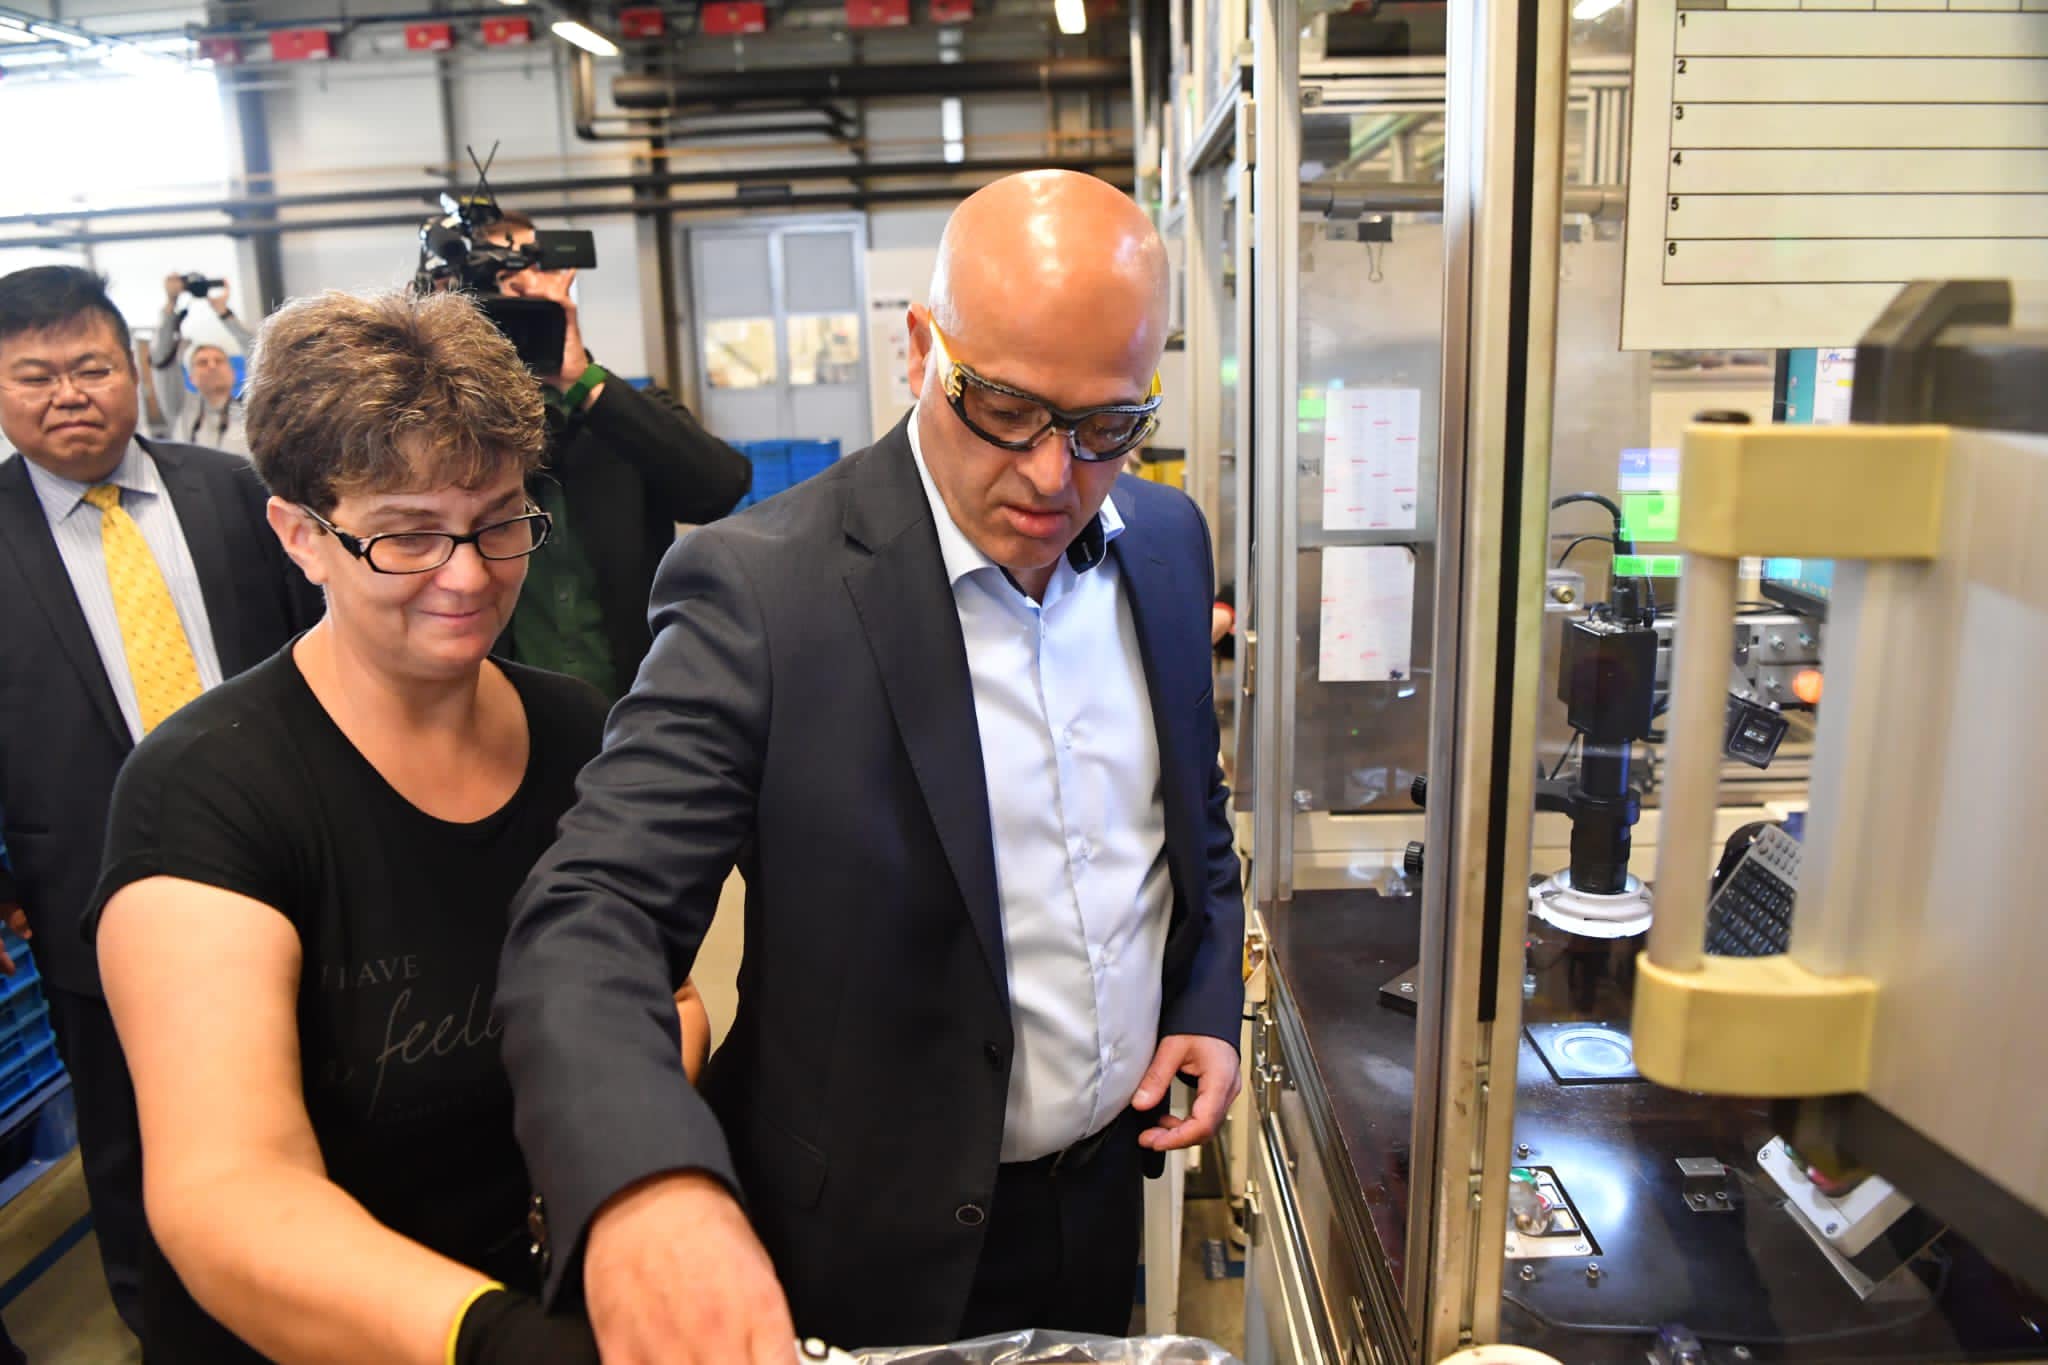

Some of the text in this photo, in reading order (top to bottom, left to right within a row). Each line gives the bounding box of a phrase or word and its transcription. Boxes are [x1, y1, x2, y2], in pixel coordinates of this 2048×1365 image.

[1680, 14, 1687, 27] 1
[1677, 60, 1687, 74] 2
[1675, 106, 1684, 120] 3
[1673, 152, 1683, 166] 4
[1670, 197, 1679, 211] 5
[1667, 242, 1677, 256] 6
